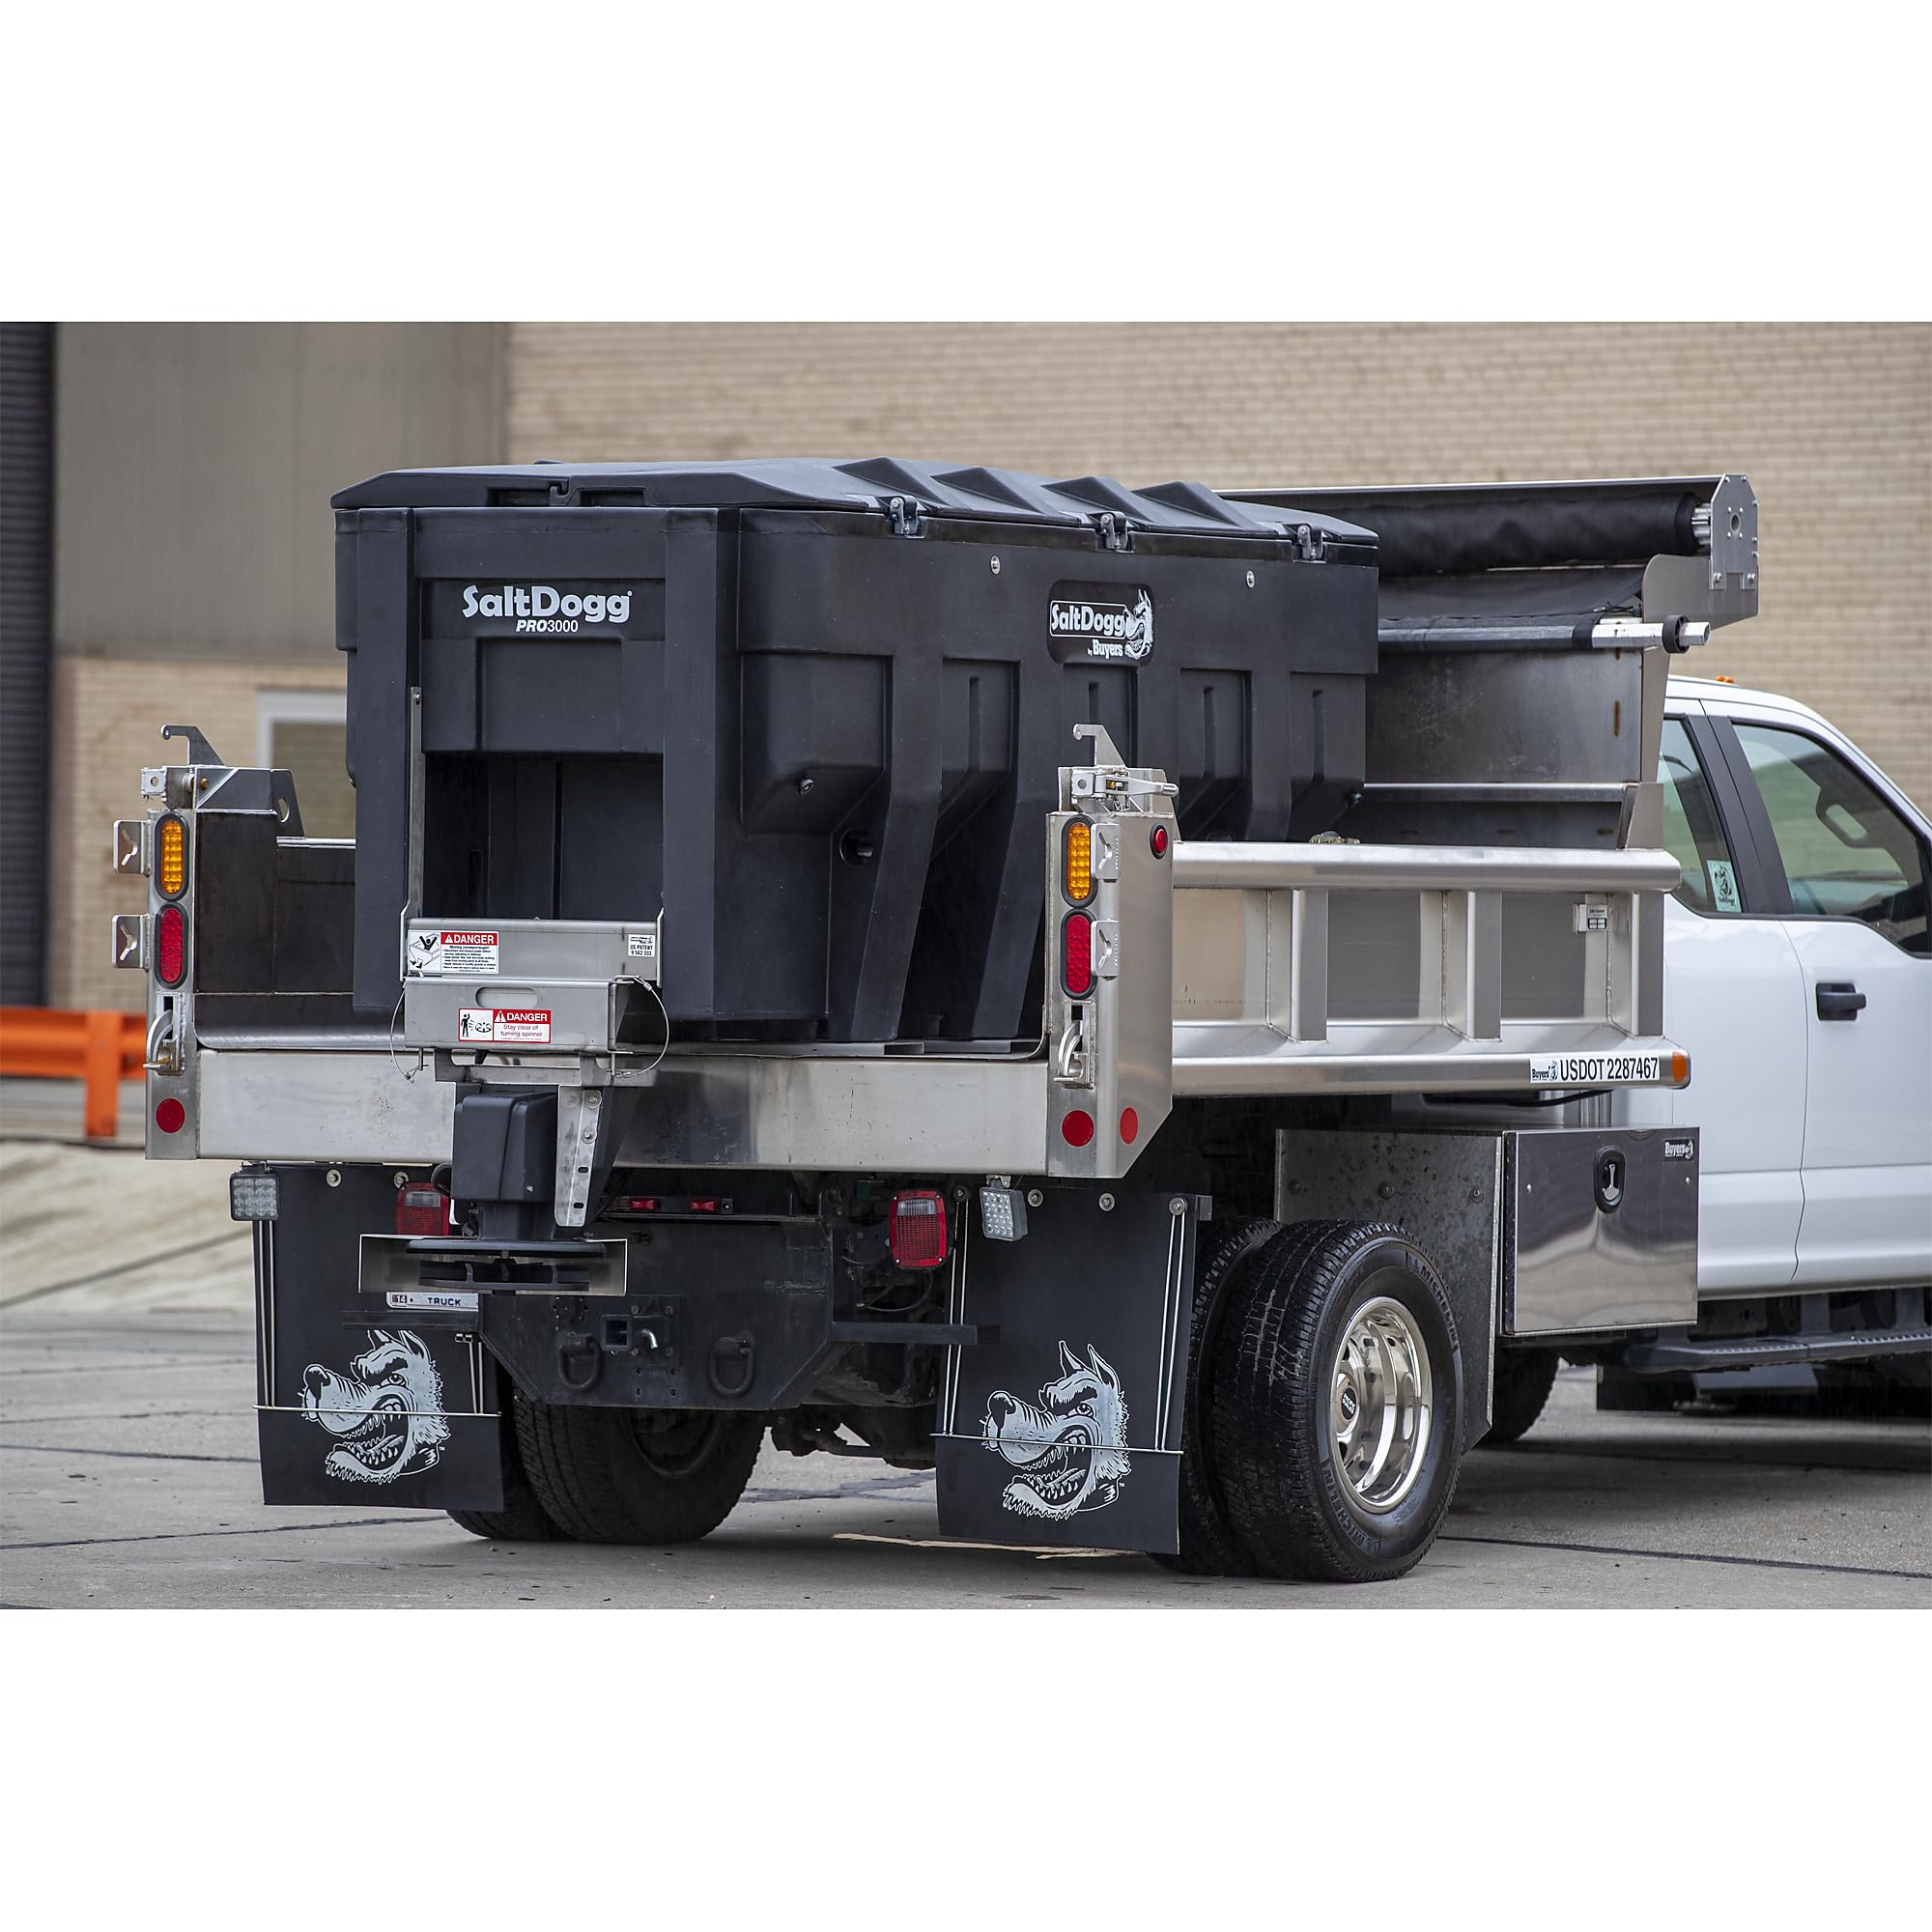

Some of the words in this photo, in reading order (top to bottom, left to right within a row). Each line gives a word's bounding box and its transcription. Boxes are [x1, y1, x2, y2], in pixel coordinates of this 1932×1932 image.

[462, 584, 631, 623] SaltDogg
[515, 619, 579, 633] PRO3000
[1051, 604, 1125, 637] SaltDogg
[1093, 639, 1123, 659] Buyers
[453, 934, 495, 944] DANGER
[506, 1012, 548, 1022] DANGER
[1560, 1059, 1605, 1081] USDOT
[1606, 1057, 1659, 1080] 2287467
[427, 1297, 461, 1306] TRUCK
